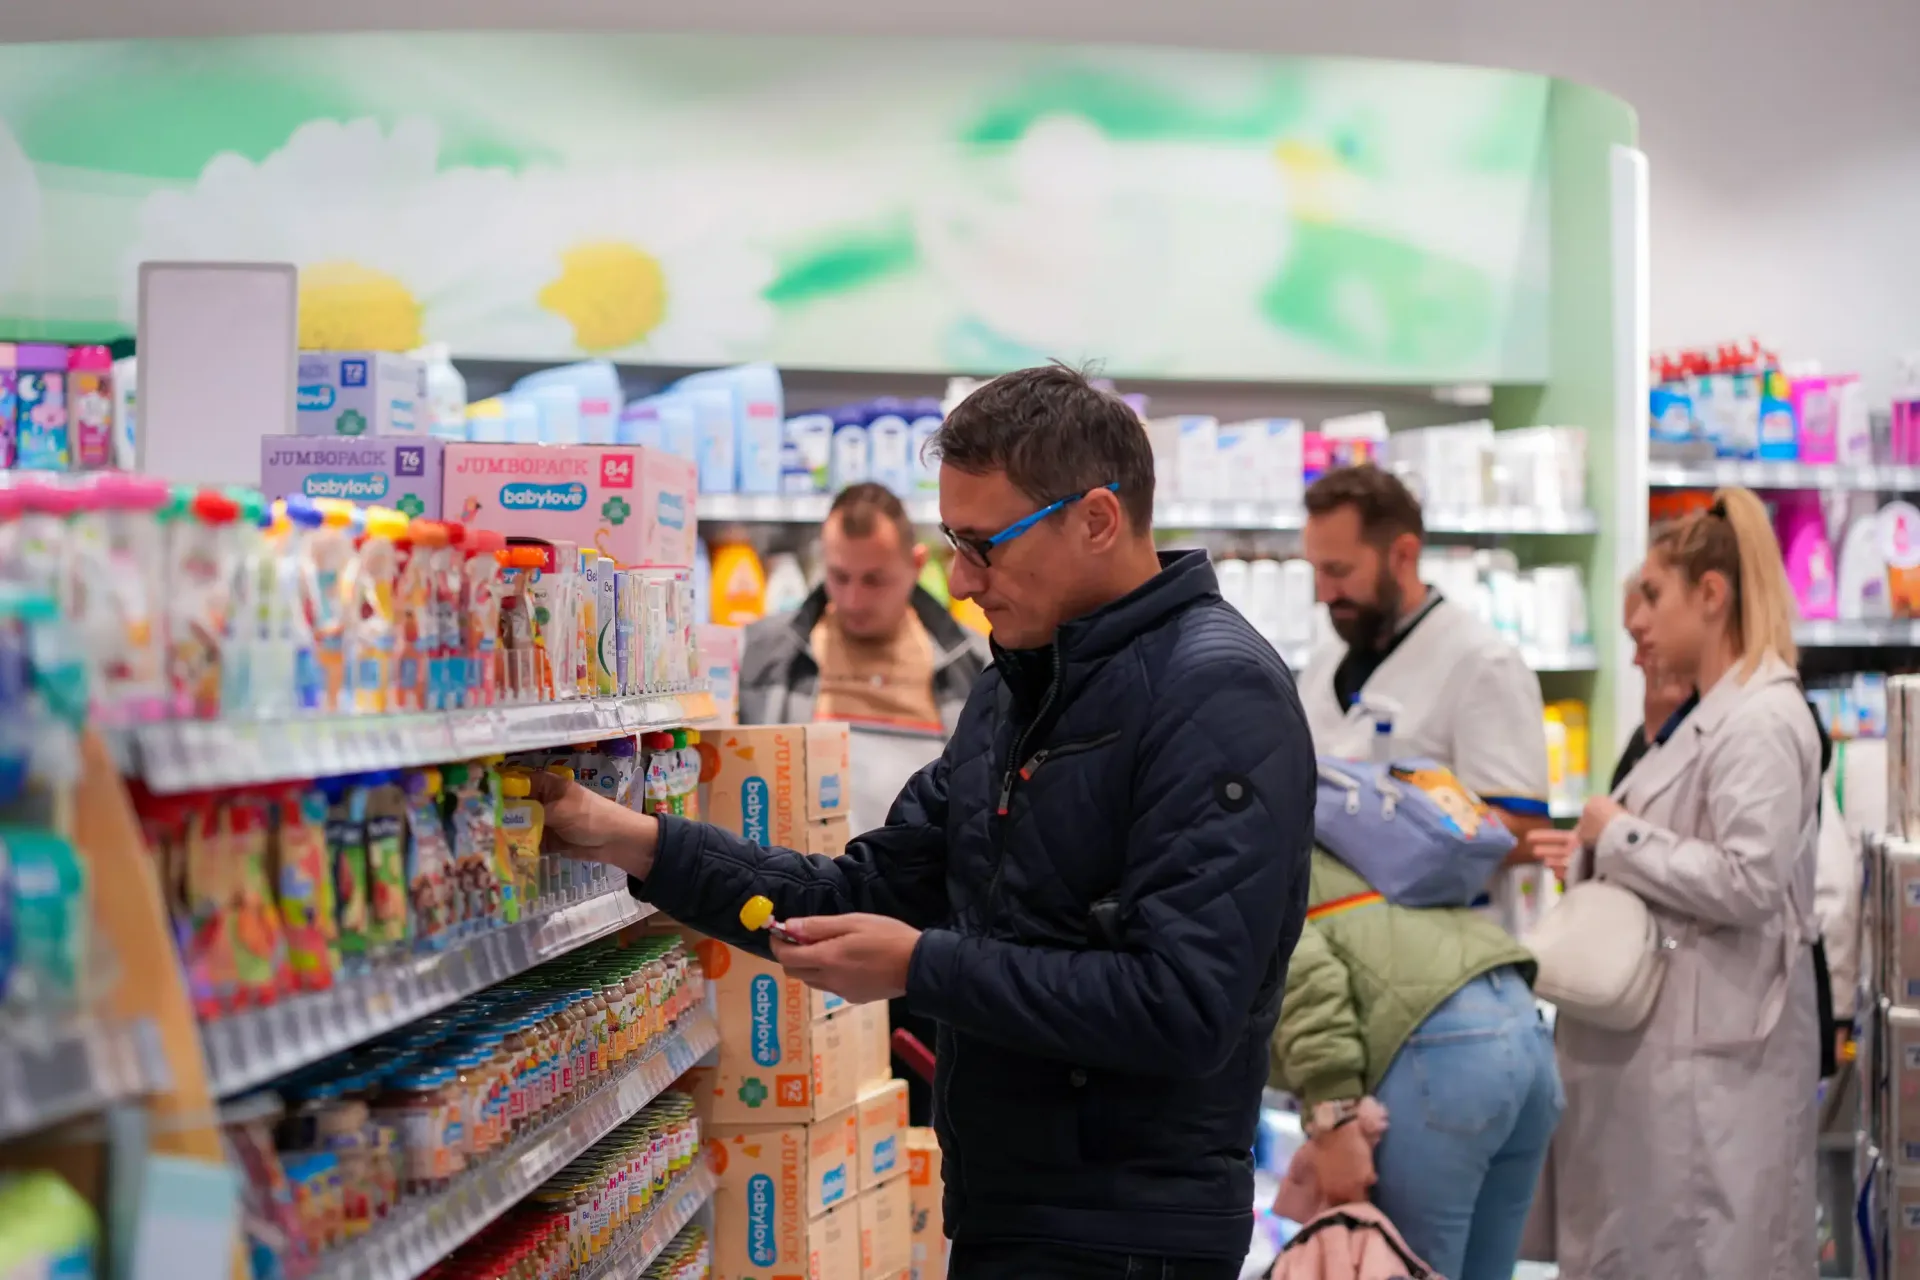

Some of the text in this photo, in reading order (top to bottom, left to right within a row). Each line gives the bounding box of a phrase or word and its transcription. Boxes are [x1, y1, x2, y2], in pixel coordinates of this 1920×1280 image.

[269, 450, 387, 466] JUMBOPACK
[400, 451, 420, 465] 76
[456, 457, 588, 475] JUMBOPACK
[604, 460, 630, 476] 84
[306, 478, 385, 497] babylove
[504, 488, 582, 508] babylove
[775, 733, 792, 848] JUMBOPAC
[746, 781, 762, 847] babylo
[754, 979, 771, 1062] babylove
[785, 976, 803, 1064] BOPACK
[788, 1079, 802, 1102] 92
[782, 1133, 799, 1264] JUMBOPACK
[751, 1179, 768, 1262] babylove
